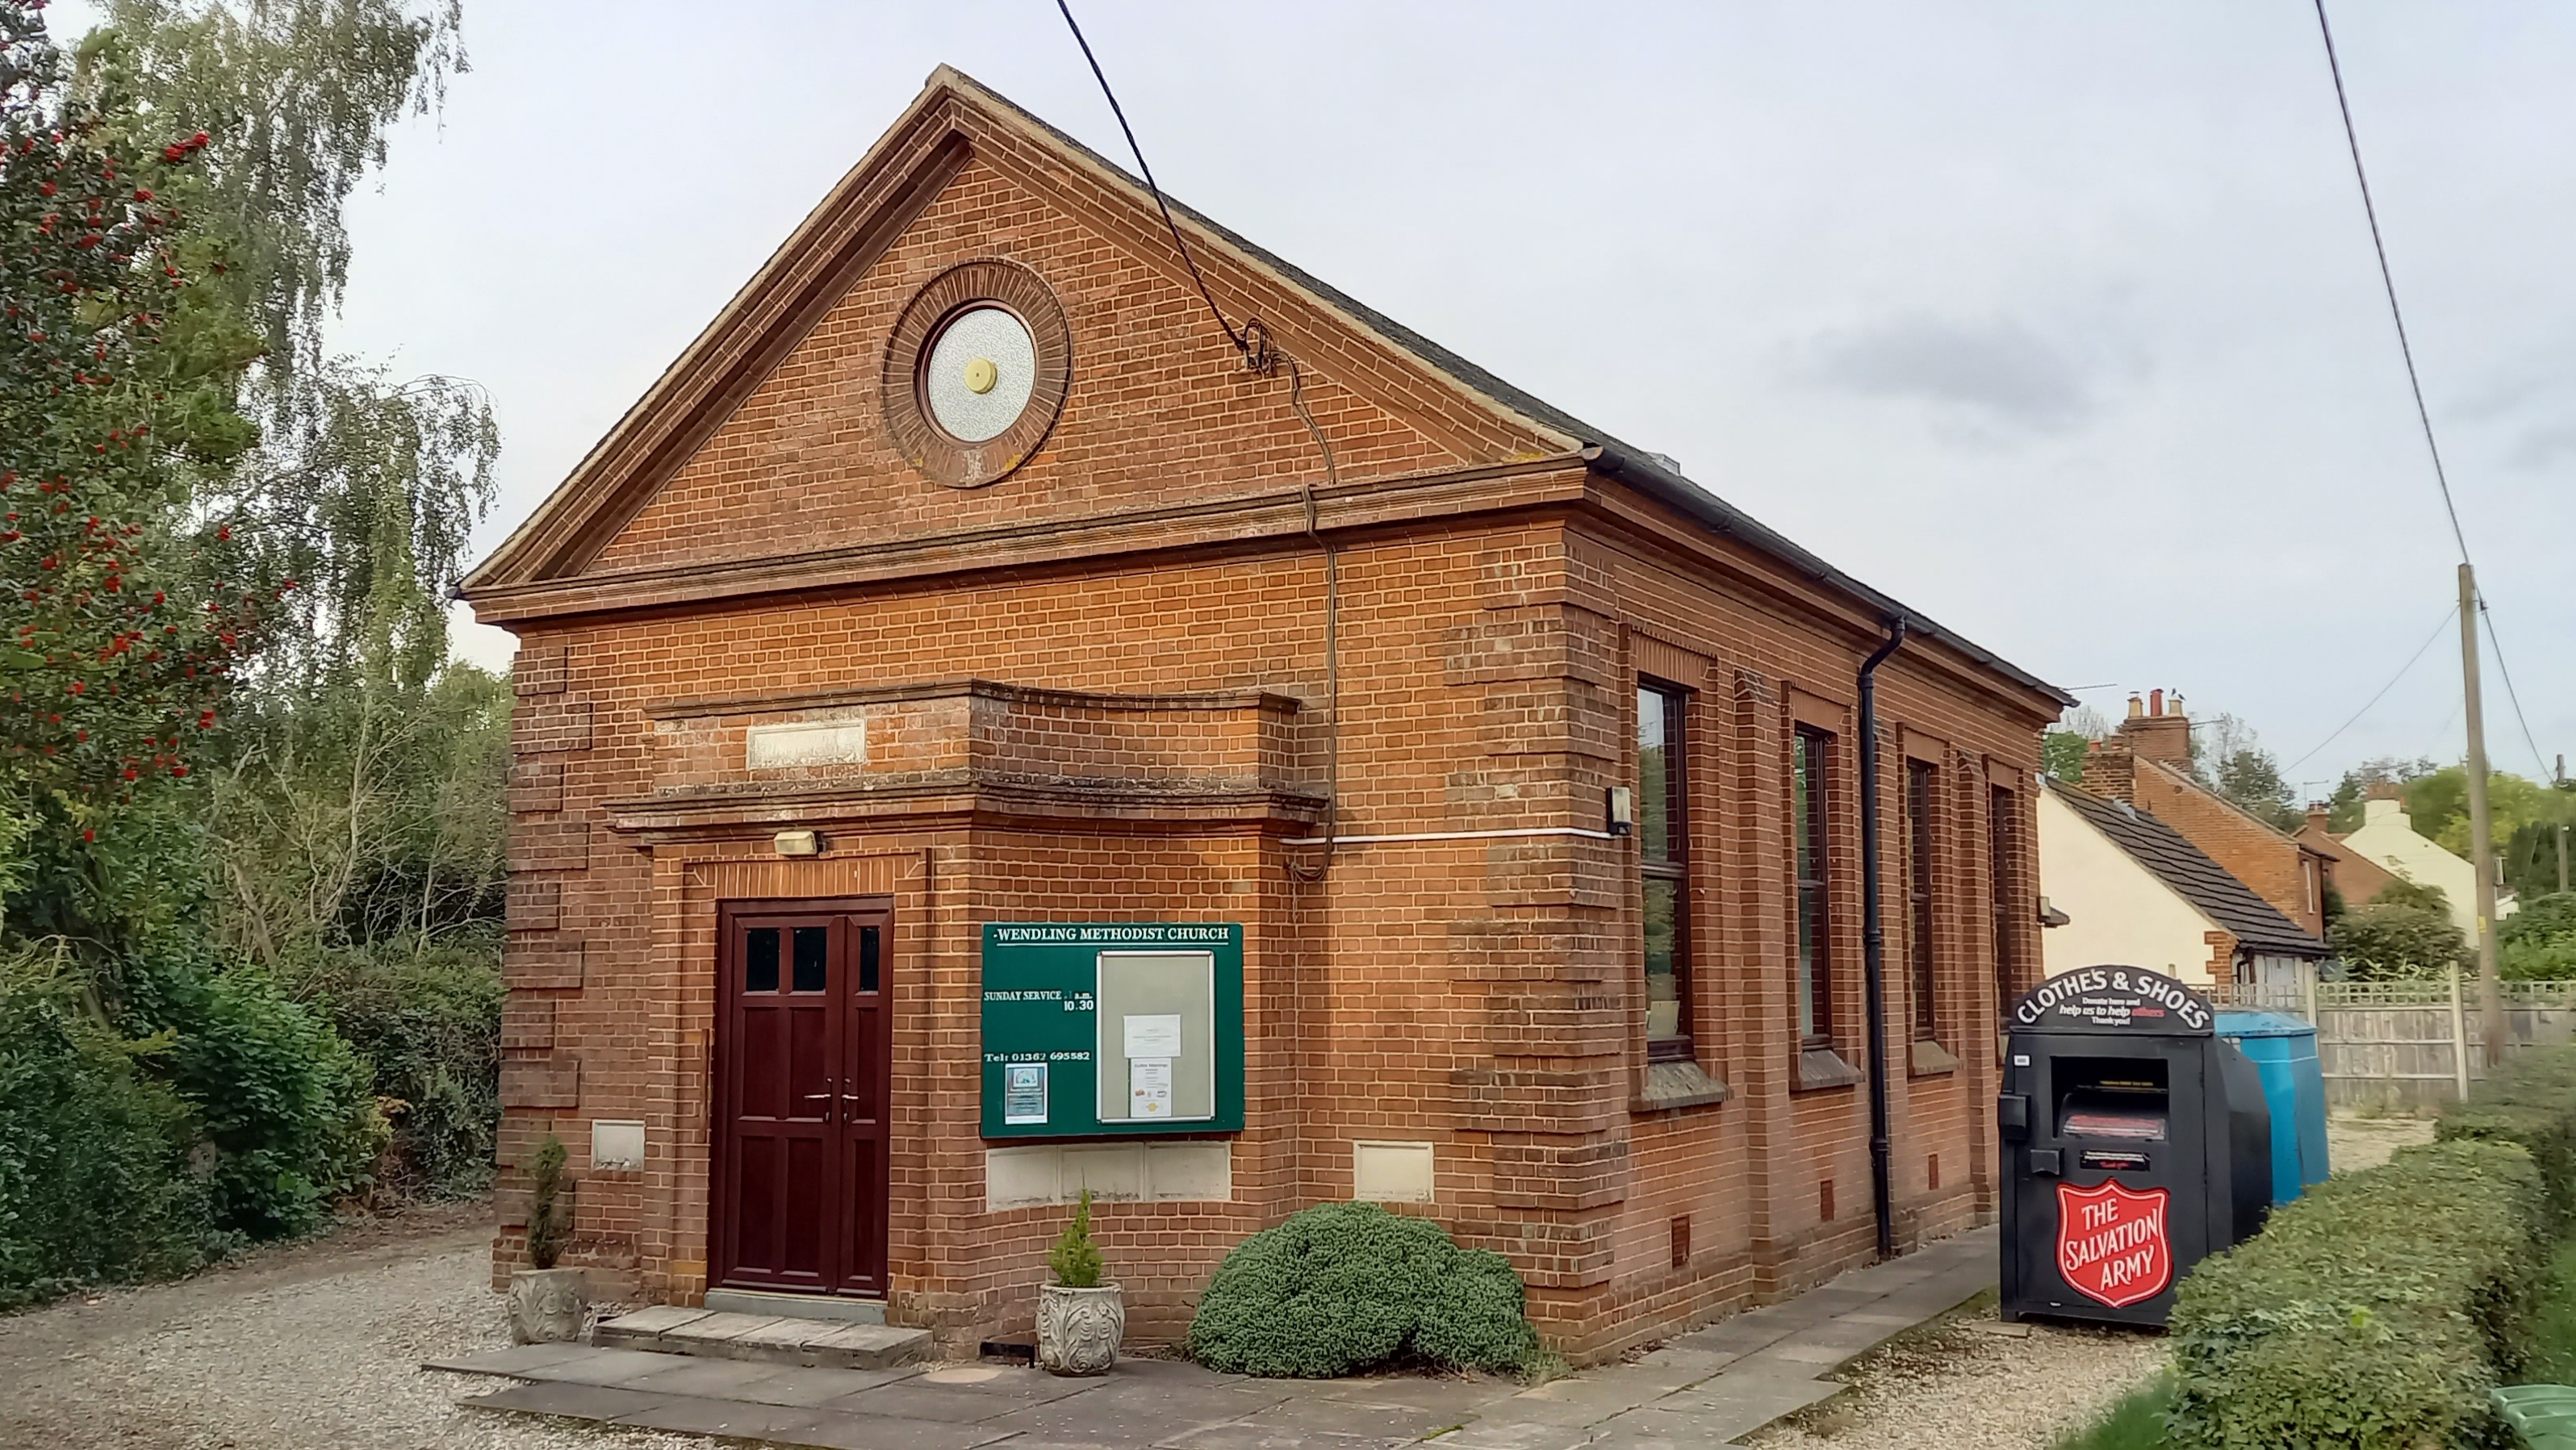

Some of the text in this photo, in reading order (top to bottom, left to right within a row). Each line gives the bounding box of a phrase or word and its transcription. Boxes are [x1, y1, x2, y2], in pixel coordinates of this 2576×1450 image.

[1080, 928, 1165, 940] METHODIST
[1168, 927, 1229, 939] CHURCH
[984, 991, 1093, 1001] SUNDAY SERVICE a.m.
[2018, 968, 2210, 1029] CLOTHES & SHOES
[2082, 997, 2141, 1006] Donate here and
[2059, 1005, 2081, 1017] help
[2082, 1007, 2095, 1015] us
[2096, 1006, 2106, 1015] to
[2107, 1005, 2131, 1018] help
[2092, 1016, 2114, 1025] Thank
[1011, 1052, 1046, 1061] 01362
[1050, 1051, 1090, 1060] 695582
[2081, 1197, 2118, 1231] THE
[2066, 1208, 2159, 1271] SALVATION
[2100, 1244, 2154, 1291] ARMY
